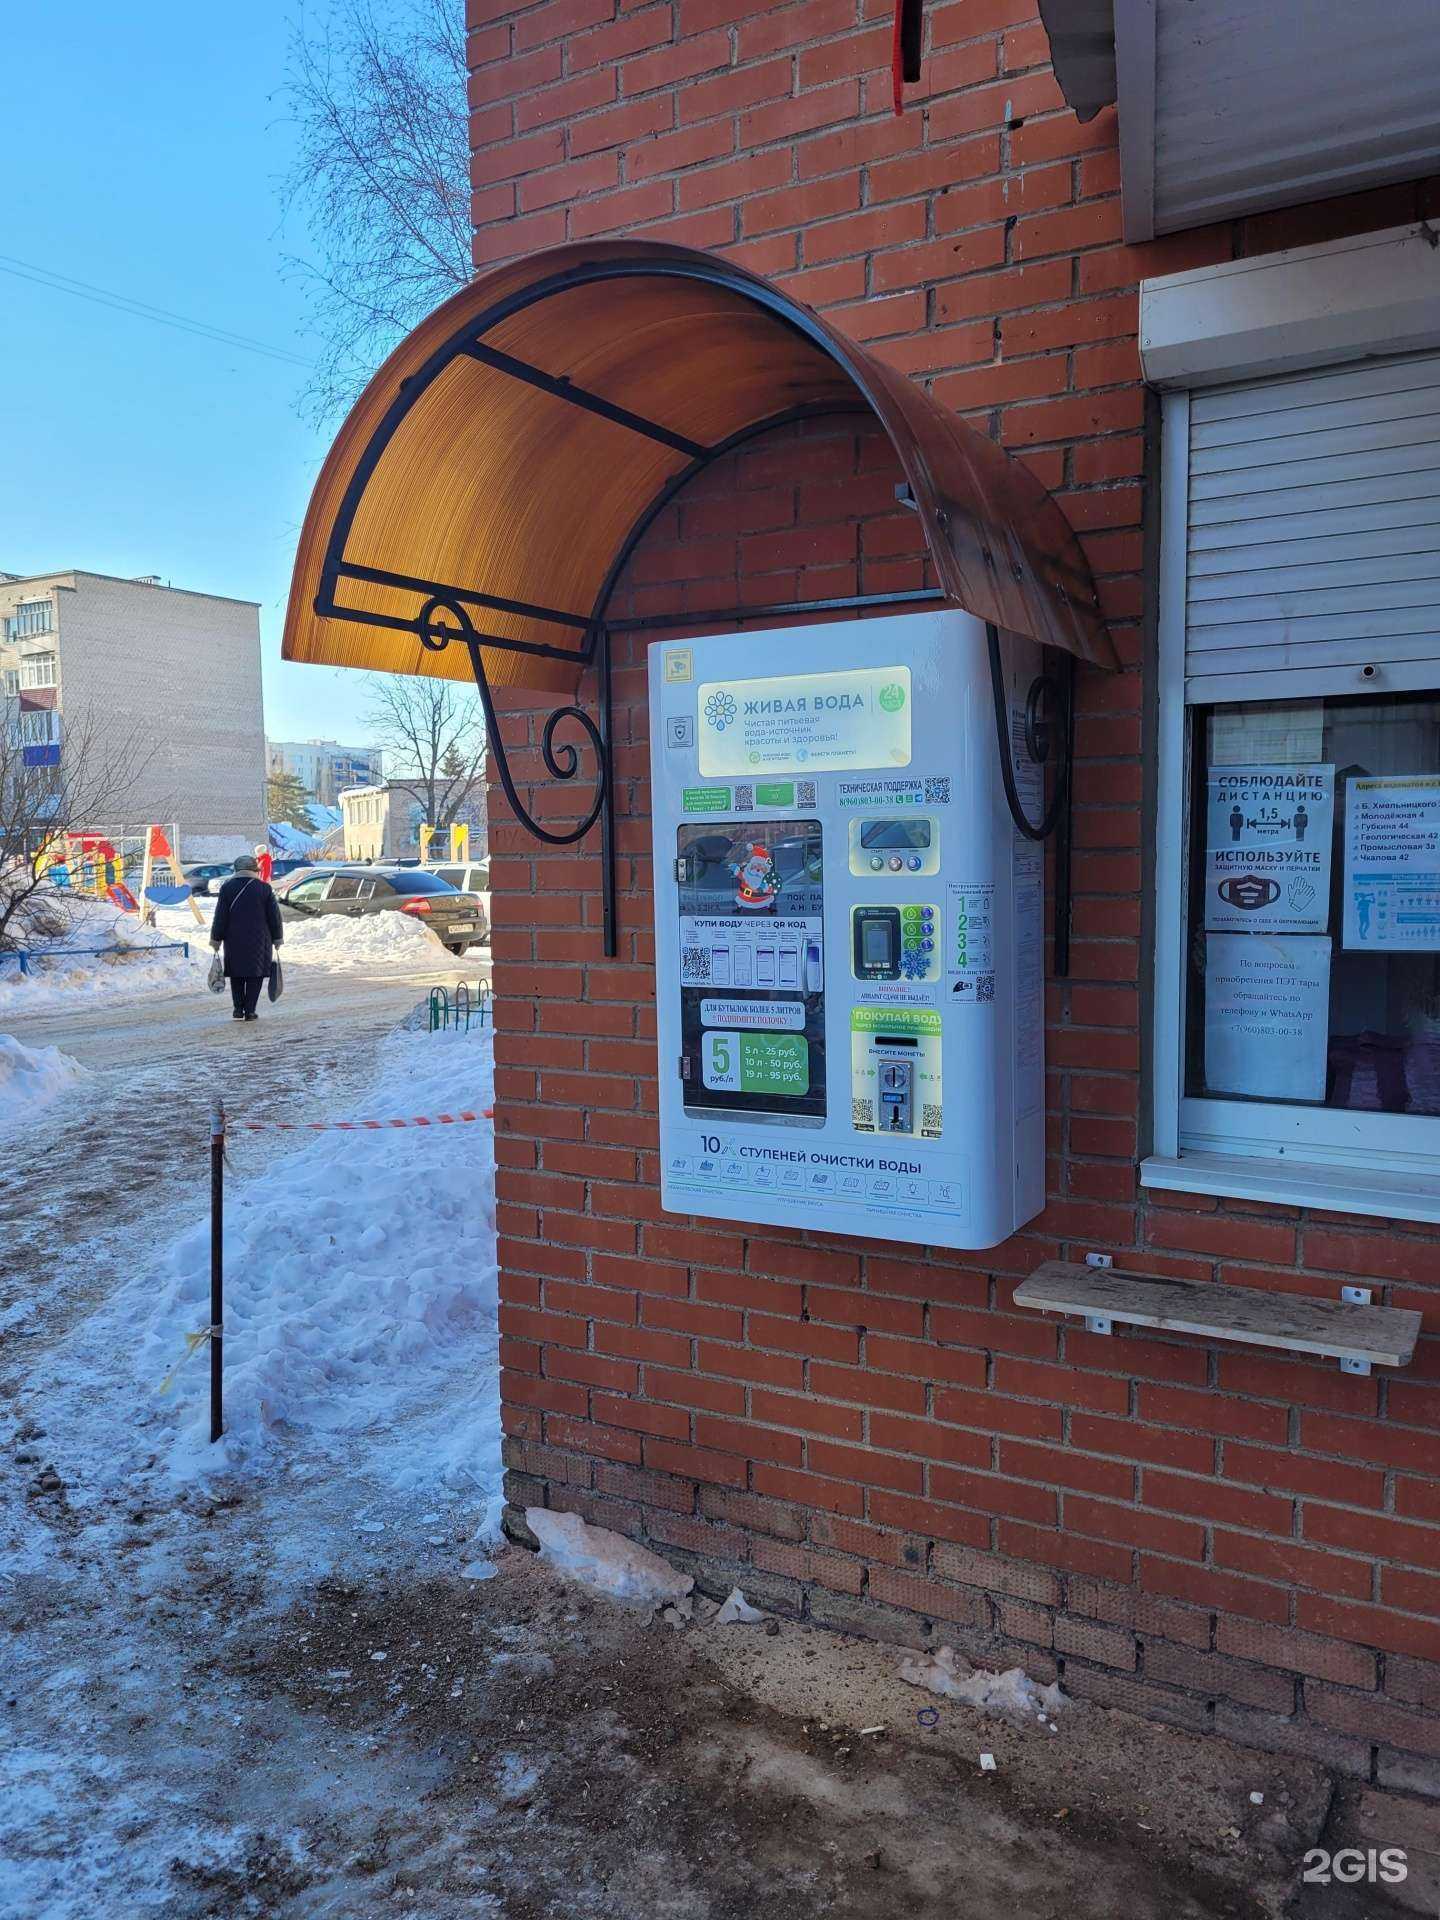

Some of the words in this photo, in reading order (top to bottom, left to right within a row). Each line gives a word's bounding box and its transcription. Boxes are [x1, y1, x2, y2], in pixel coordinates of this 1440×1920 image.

[743, 698, 807, 716] ЖИВАЯ
[814, 694, 865, 711] ВОДА
[744, 719, 775, 728] Чистая
[778, 716, 820, 726] питьевая
[744, 726, 812, 738] вода-источник
[744, 736, 783, 747] красоты
[792, 733, 839, 745] здоровья!
[839, 782, 883, 794] ТЕХНИЧЕСКАЯ
[884, 780, 923, 793] ПОДДЕРЖКА
[1218, 773, 1324, 789] СОБЛЮДАЙТЕ
[1217, 791, 1323, 803] ДИСТАНЦИЮ
[1260, 808, 1278, 821] 1,5
[1361, 812, 1417, 820] Молодёжная
[1360, 844, 1423, 852] Промысловая
[1215, 850, 1321, 863] ИСПОЛЬЗУЙТЕ
[958, 896, 966, 913] 1
[774, 921, 785, 929] QR
[788, 921, 807, 930] КОД
[958, 914, 968, 930] 2
[958, 933, 967, 950] 3
[958, 952, 968, 969] 4
[1240, 960, 1252, 968] По
[1254, 962, 1295, 970] вопросам
[1215, 976, 1273, 985] приобретения
[1276, 978, 1297, 986] ПЭТ
[1233, 992, 1288, 1002] обращайтесь
[704, 1004, 718, 1012] ДЛЯ
[719, 1004, 748, 1013] БУТЫЛОК
[748, 1005, 769, 1014] БОЛЕЕ
[770, 1006, 775, 1014] 5
[776, 1006, 801, 1015] ЛИТРОВ
[1221, 1008, 1259, 1018] телефону
[1270, 1010, 1313, 1020] WhatsApp
[855, 1011, 911, 1022] ПОКУПАЙ
[913, 1014, 942, 1026] ВОДУ
[712, 1038, 730, 1074] 5
[745, 1046, 751, 1054] 5
[766, 1047, 777, 1056] 25
[779, 1047, 797, 1057] руб.
[898, 1050, 925, 1058] МОНЕТЫ
[745, 1058, 755, 1066] 10
[771, 1059, 781, 1067] 50
[784, 1060, 802, 1069] руб.
[746, 1070, 755, 1078] 19
[770, 1072, 781, 1080] 95
[783, 1072, 802, 1081] руб.
[701, 1136, 721, 1154] 10
[740, 1147, 806, 1164] СТУПЕНЕЙ
[811, 1153, 875, 1170] ОЧИСТКИ
[879, 1160, 922, 1175] ВОДЫ
